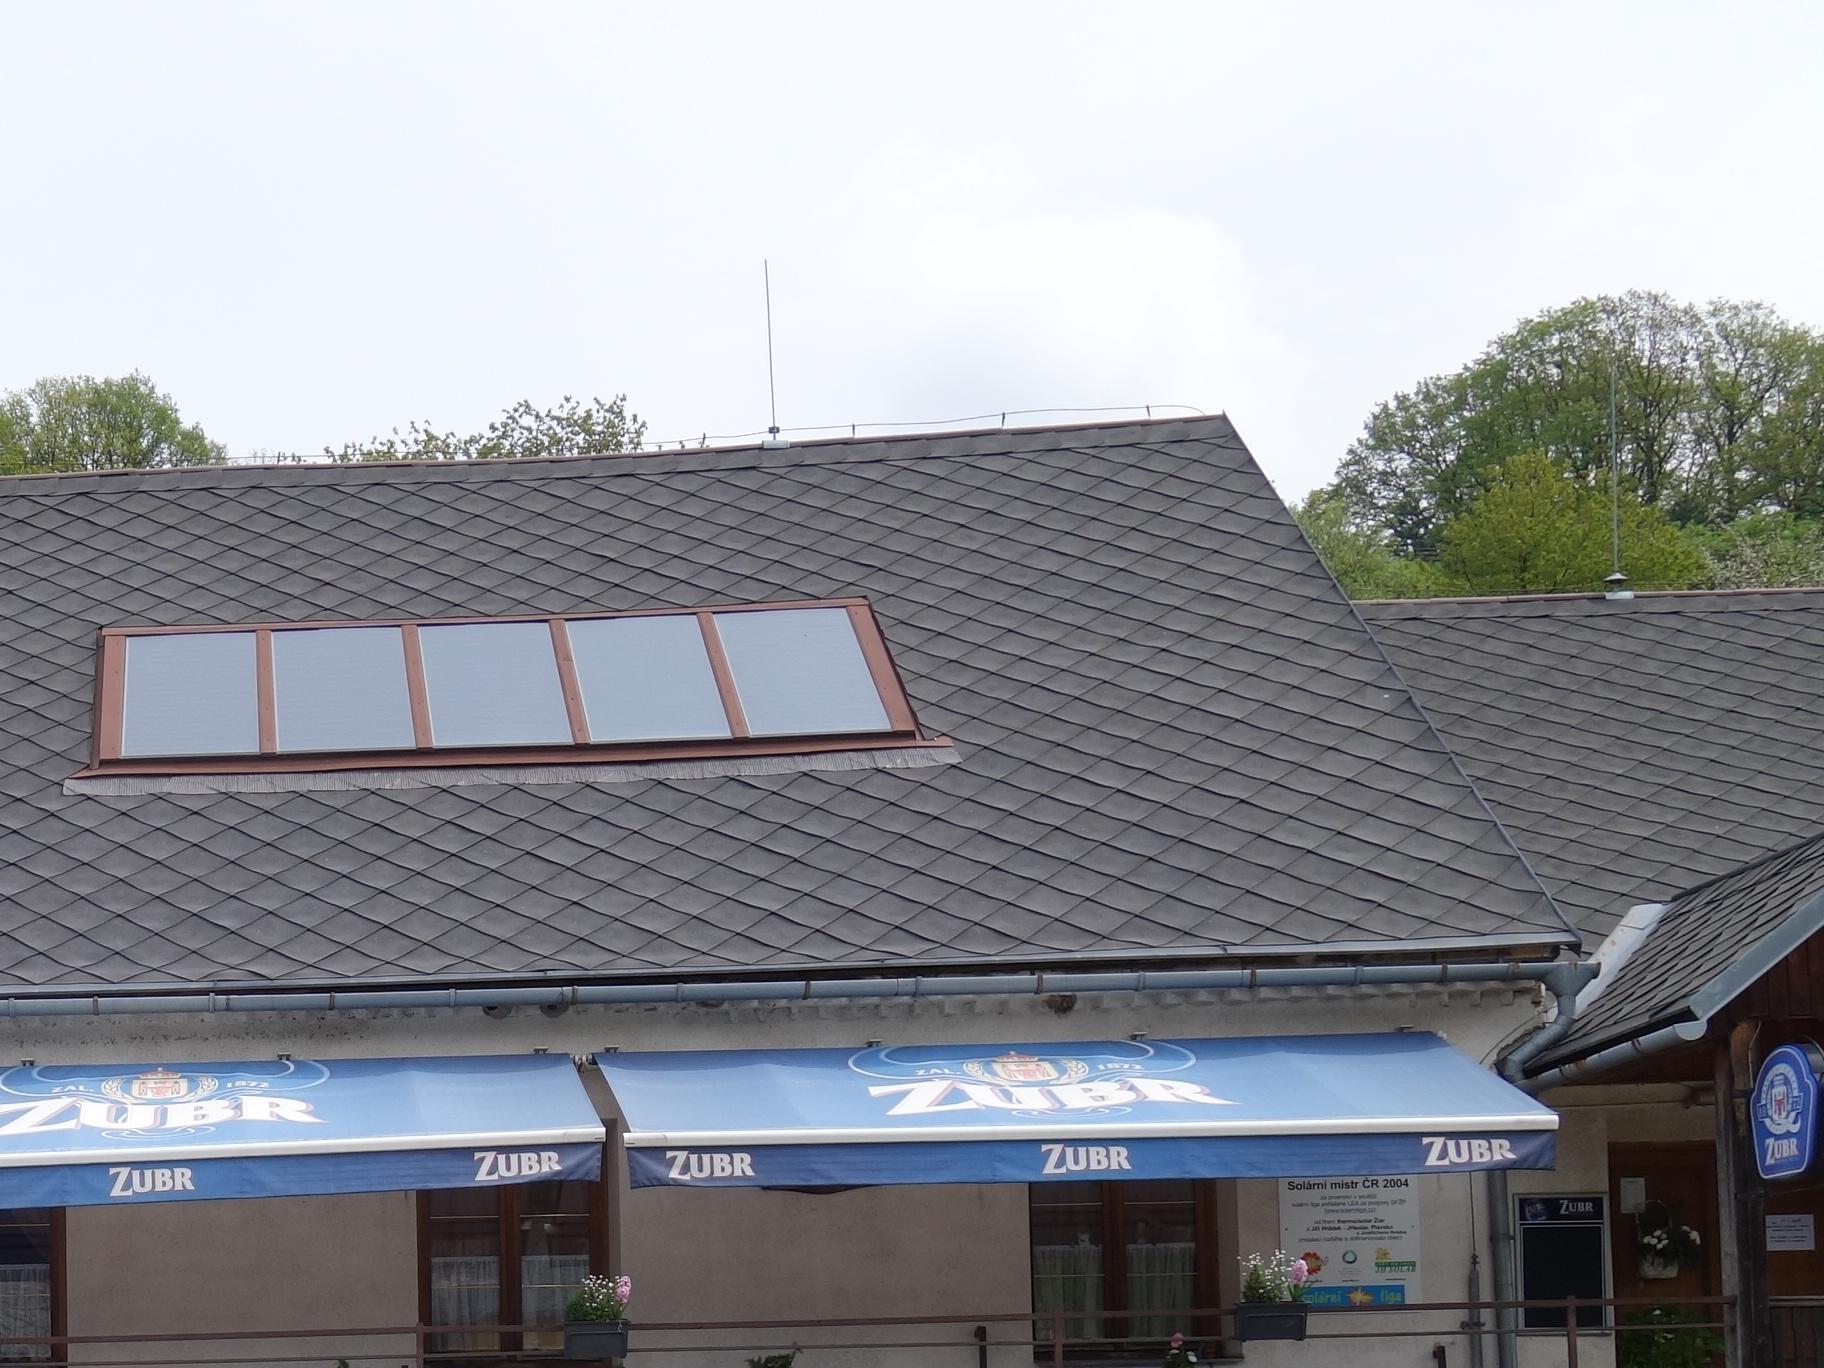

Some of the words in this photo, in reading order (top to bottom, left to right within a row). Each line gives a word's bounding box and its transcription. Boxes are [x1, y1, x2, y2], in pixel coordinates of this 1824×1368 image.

[868, 1078, 1242, 1116] ZUBR
[474, 1151, 562, 1181] ZUBR
[665, 1151, 756, 1180] ZUBR
[1041, 1143, 1132, 1175] ZUBR
[1421, 1136, 1517, 1167] ZUBR
[1765, 1138, 1799, 1166] ZUBR
[109, 1167, 195, 1197] ZUBR
[1288, 1180, 1327, 1191] Solární
[1330, 1180, 1360, 1190] mistr
[1362, 1177, 1380, 1189] ČR
[1383, 1179, 1409, 1189] 2004
[1559, 1200, 1594, 1215] ZUBR
